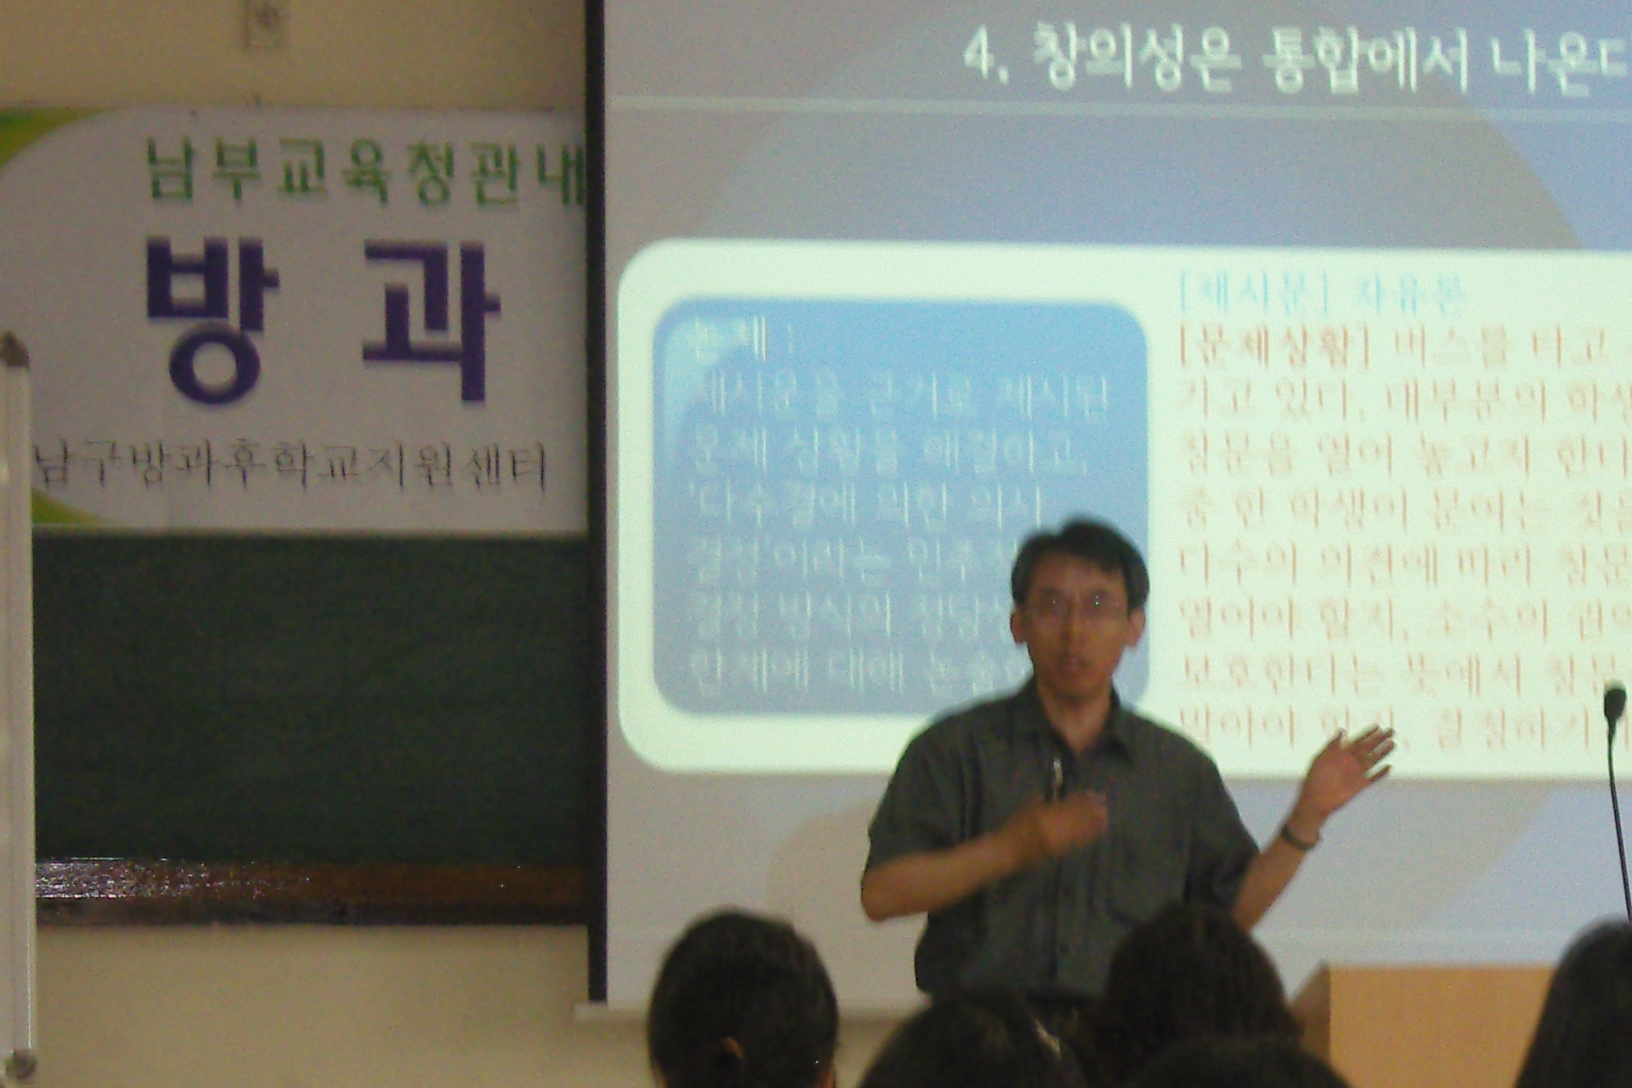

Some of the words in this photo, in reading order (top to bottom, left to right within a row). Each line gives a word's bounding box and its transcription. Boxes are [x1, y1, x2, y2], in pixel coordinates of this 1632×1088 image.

[964, 30, 1009, 85] 4.
[1033, 22, 1241, 93] 창의성은
[1262, 24, 1470, 94] 통합에서
[1393, 321, 1510, 370] 버스를
[1387, 377, 1547, 424] 대부분의
